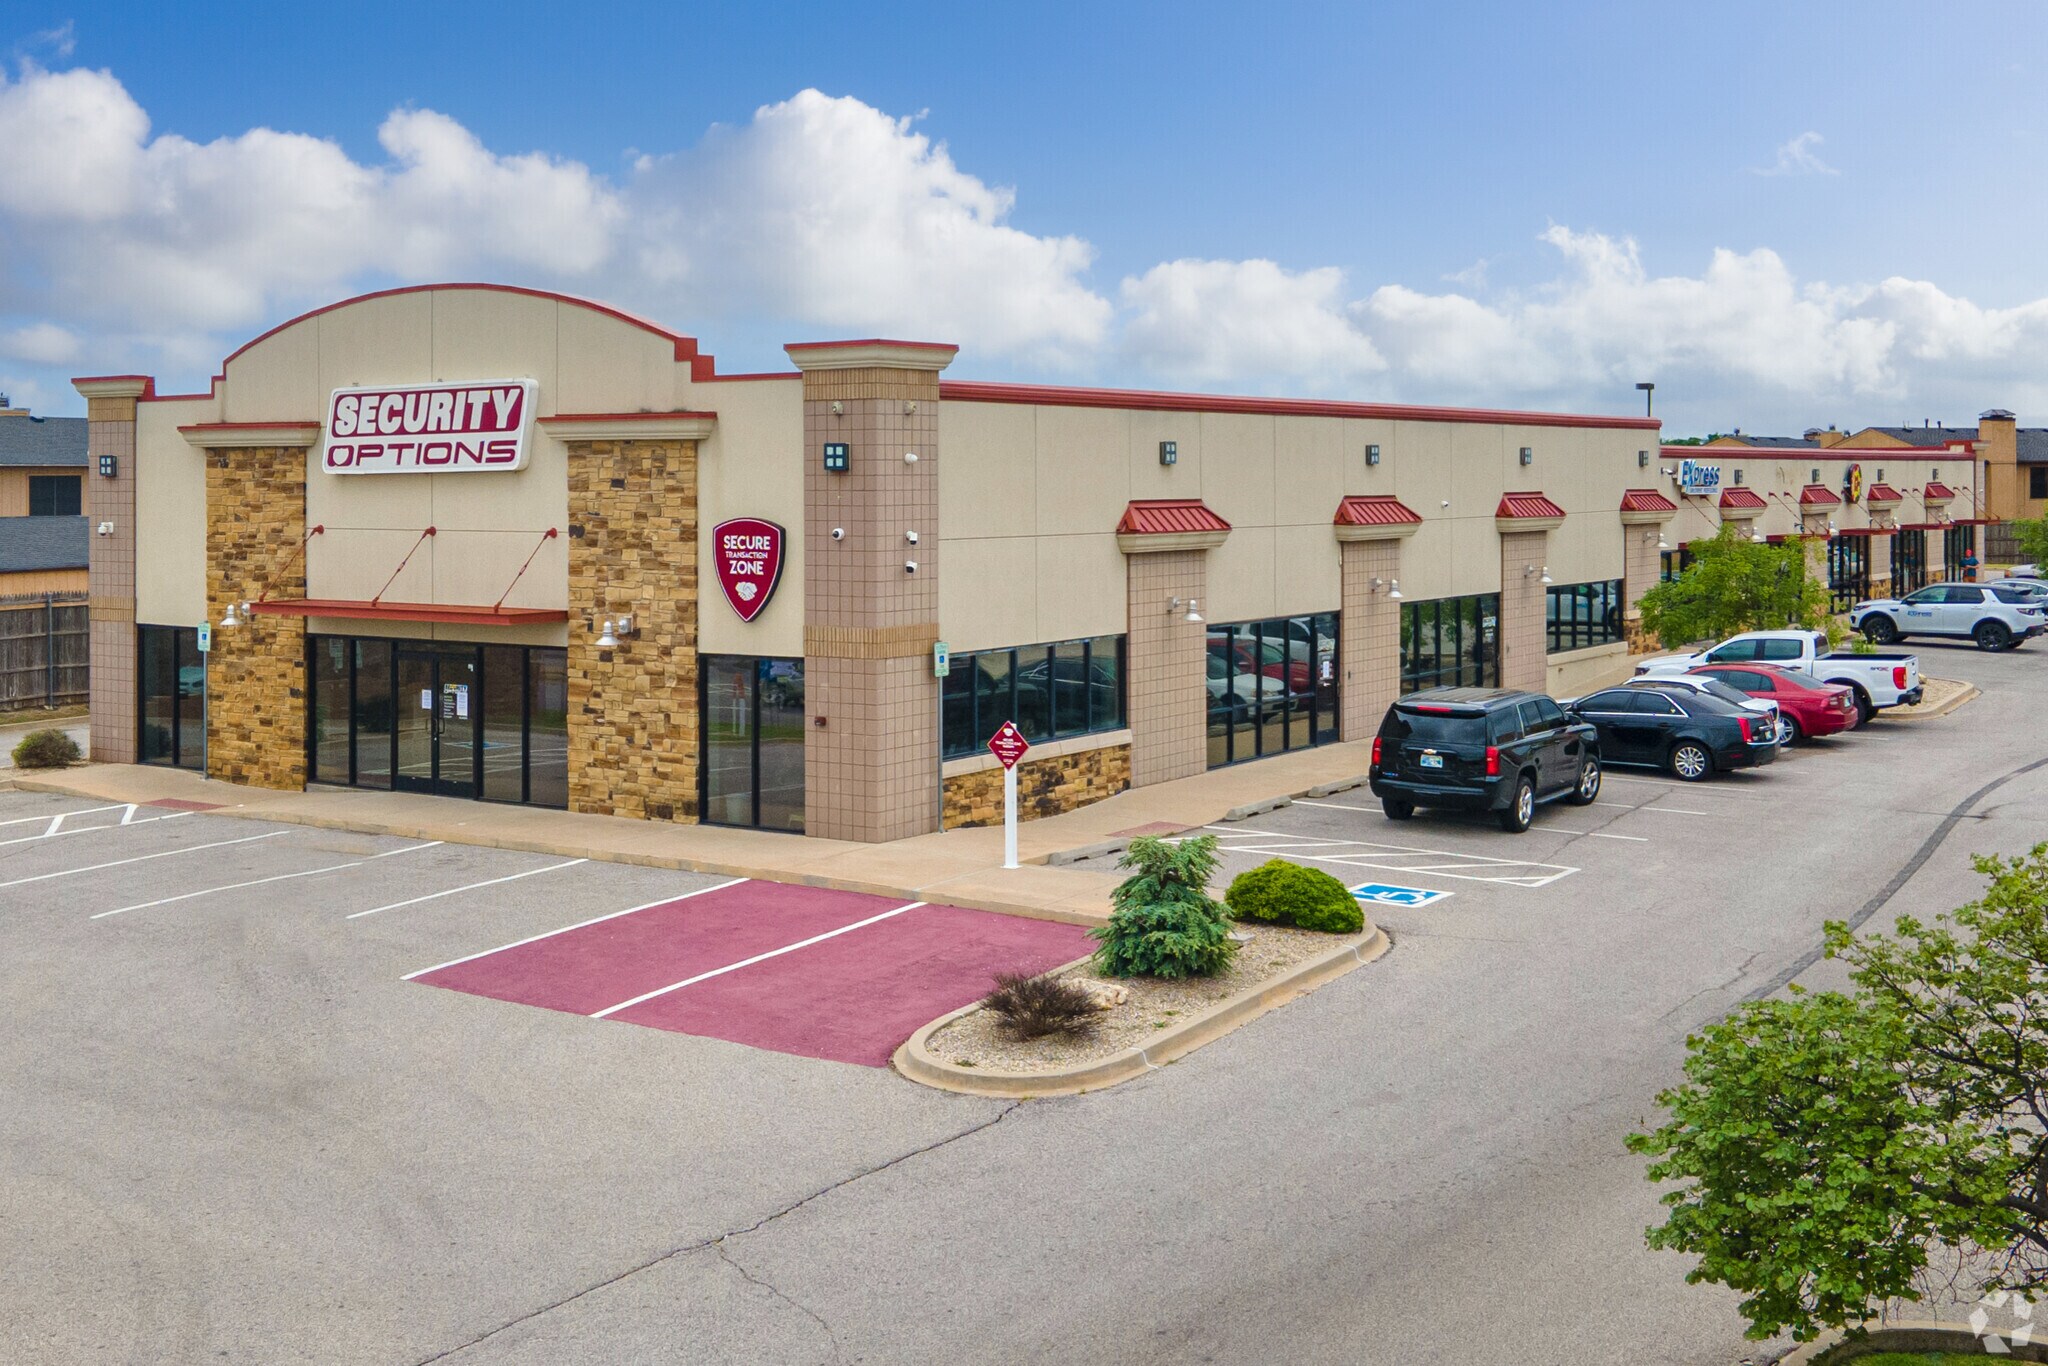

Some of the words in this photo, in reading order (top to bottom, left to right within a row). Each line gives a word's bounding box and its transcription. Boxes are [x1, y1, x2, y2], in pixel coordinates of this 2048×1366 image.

[334, 388, 521, 436] SECURITY
[327, 440, 518, 467] OPTIONS
[723, 534, 771, 550] SECURE
[725, 551, 768, 559] TRANSACTION
[729, 560, 764, 575] ZONE
